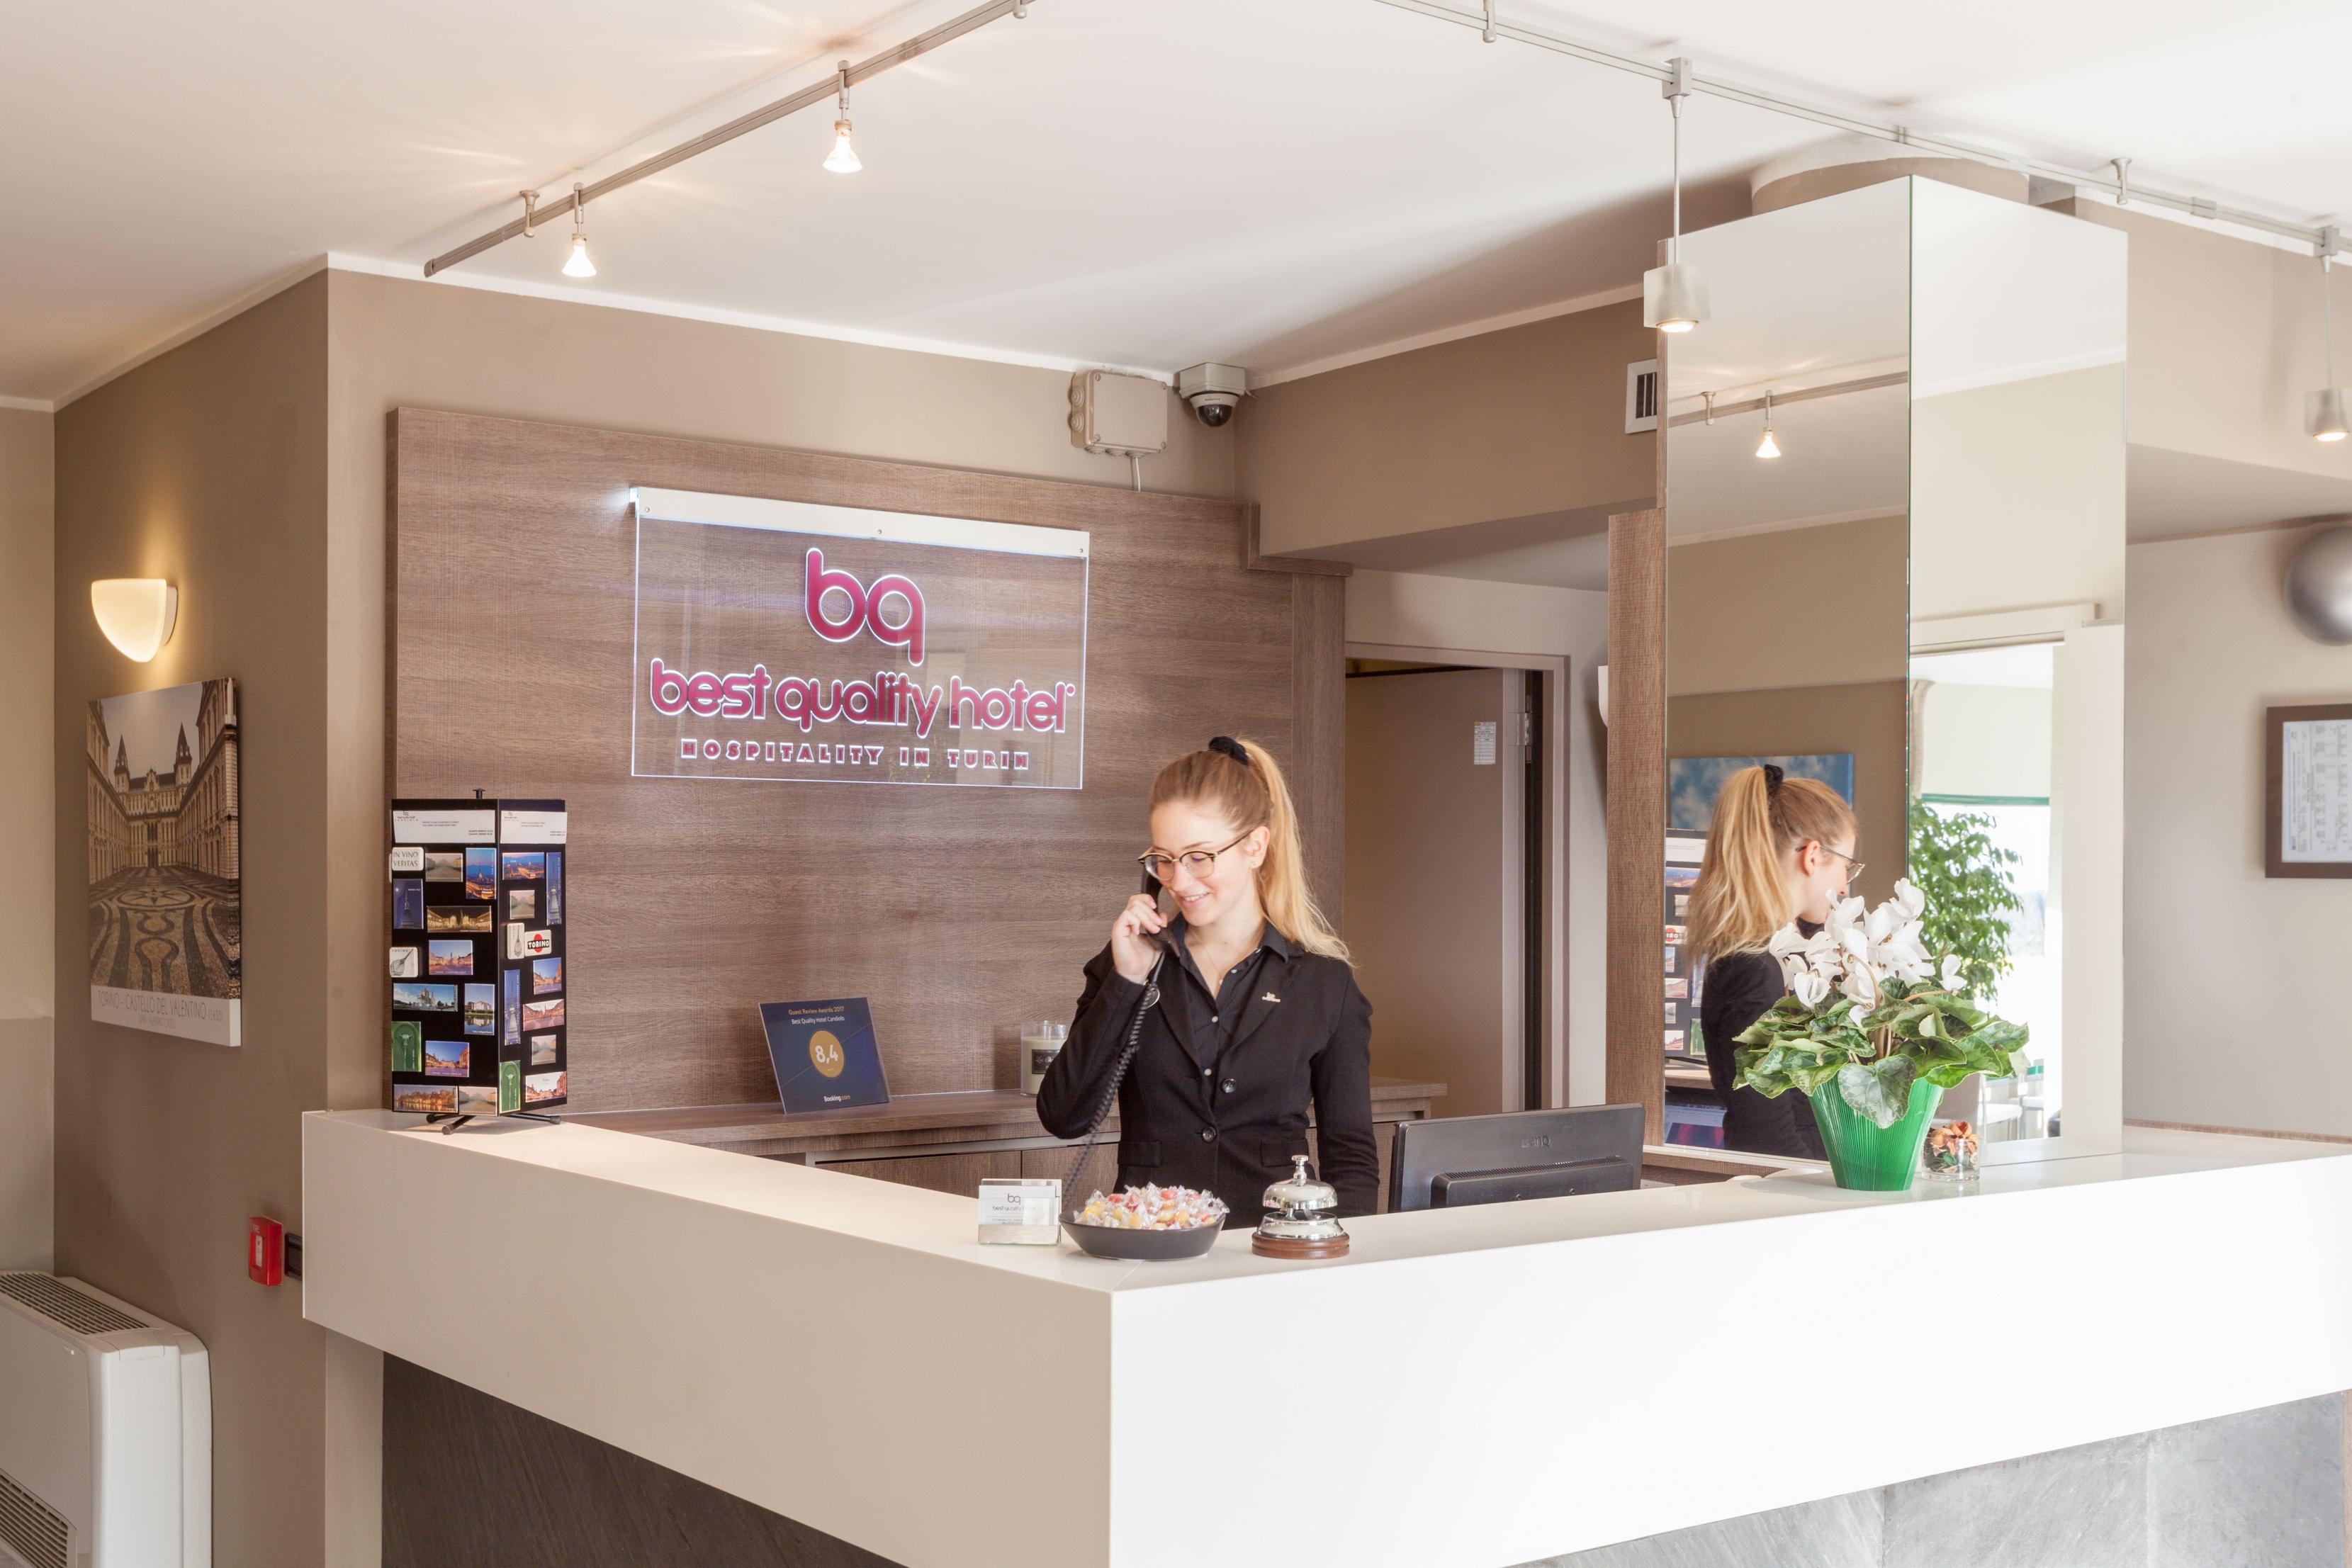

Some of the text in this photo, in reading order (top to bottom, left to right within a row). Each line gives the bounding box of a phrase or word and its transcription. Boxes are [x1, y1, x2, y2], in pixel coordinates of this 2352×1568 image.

[805, 548, 925, 666] bq
[650, 658, 1067, 739] best quality hotel
[680, 738, 1030, 770] HOSPITALITY IN TURIN
[98, 990, 120, 1010] TORINO
[125, 993, 155, 1013] CASTELLO
[157, 997, 169, 1015] DEL
[169, 998, 206, 1020] VALENTINO
[815, 1044, 838, 1064] 8,4
[1007, 1193, 1021, 1205] bq
